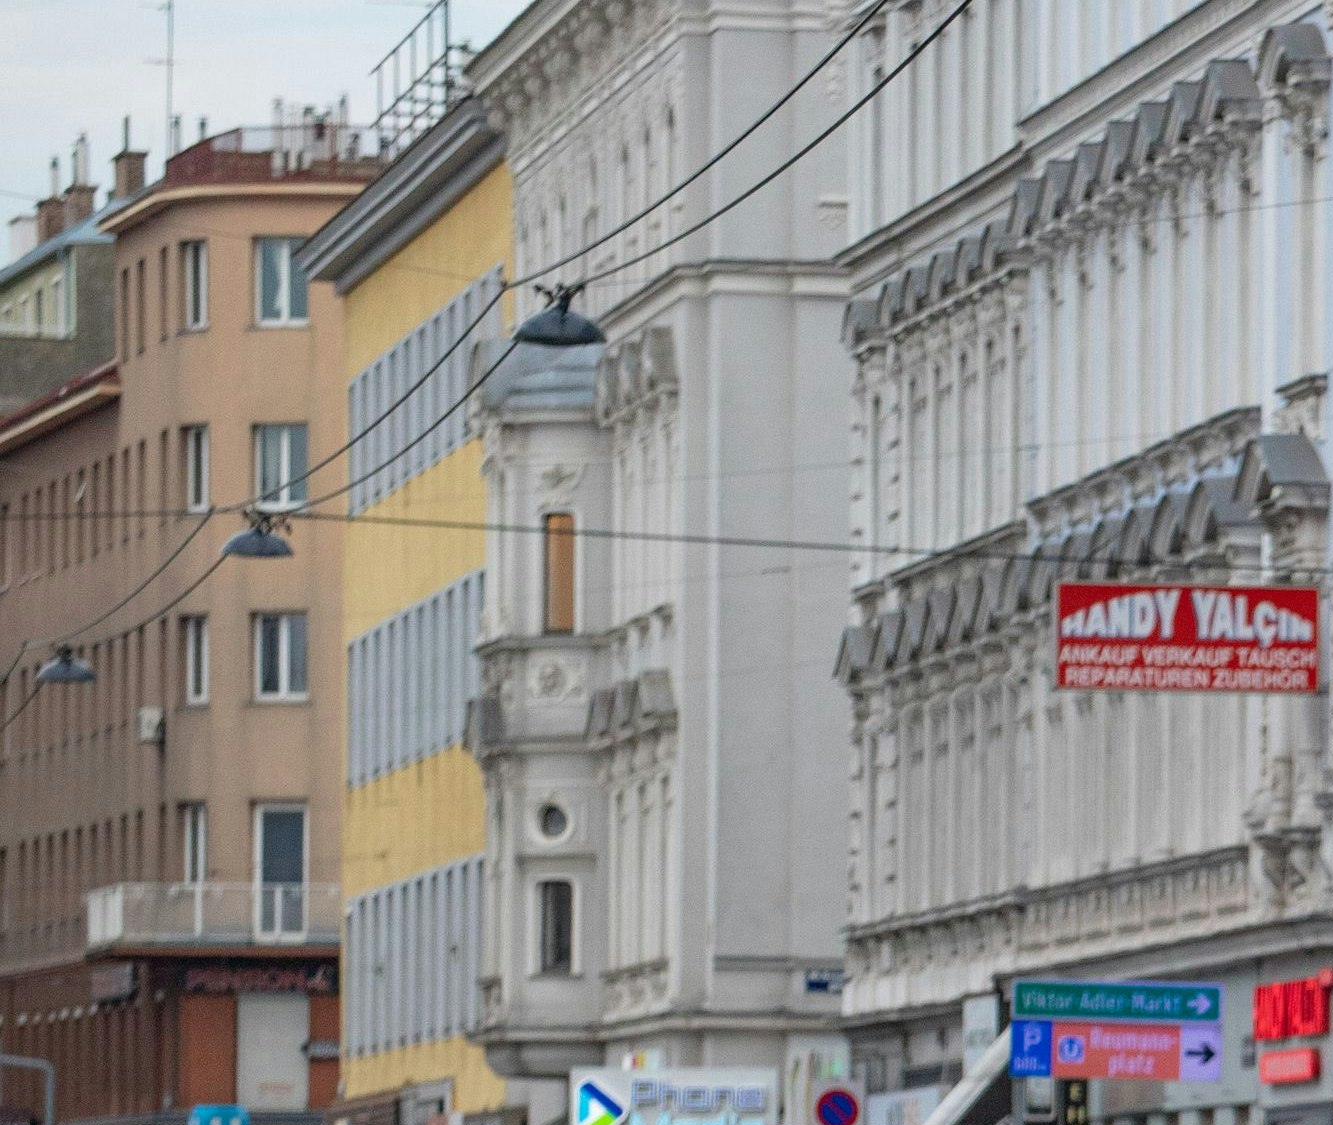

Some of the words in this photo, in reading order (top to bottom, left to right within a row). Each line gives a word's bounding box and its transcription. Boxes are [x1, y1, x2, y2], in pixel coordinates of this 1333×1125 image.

[1060, 589, 1180, 639] HANDY
[1191, 590, 1314, 649] YALÇIN
[1060, 645, 1138, 665] ANKAUF
[1141, 646, 1234, 667] VERKAUF
[1238, 647, 1316, 669] TAUSCH
[1064, 667, 1210, 687] REPARATUREN
[1023, 1022, 1041, 1053] P
[1107, 1053, 1155, 1077] platz
[631, 1078, 766, 1112] Phone
